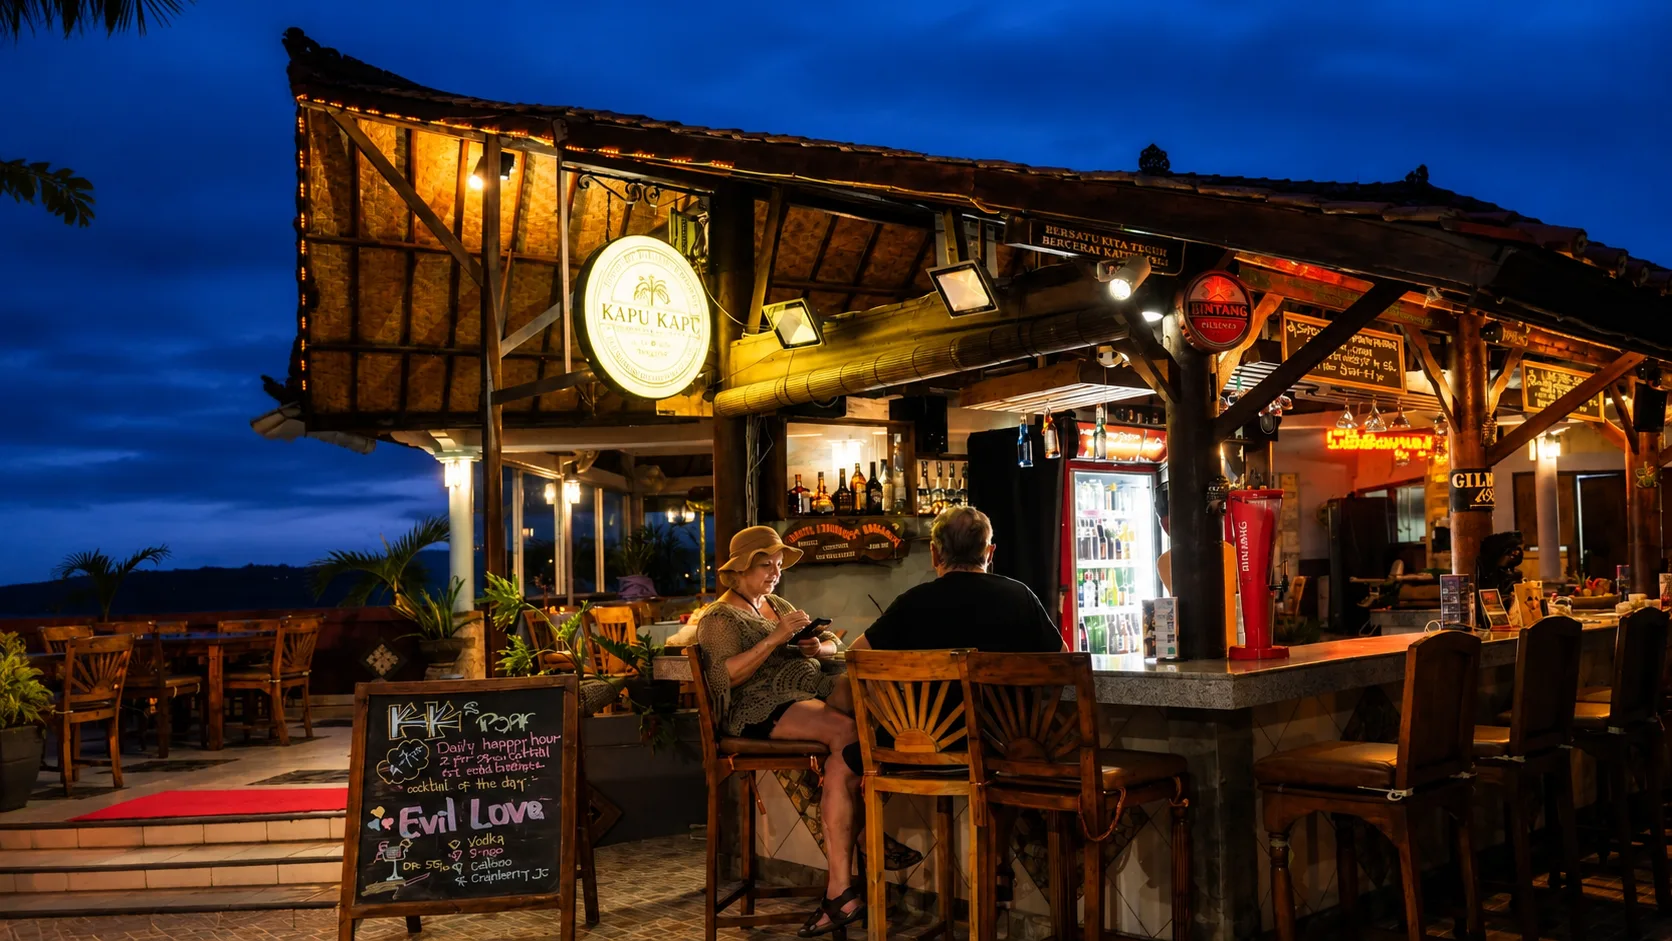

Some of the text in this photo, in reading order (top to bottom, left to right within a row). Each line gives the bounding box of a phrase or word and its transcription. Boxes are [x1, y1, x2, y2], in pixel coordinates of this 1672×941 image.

[1045, 224, 1099, 244] BERSATU
[1101, 236, 1128, 250] KITA
[602, 302, 649, 326] KAPU
[1191, 303, 1248, 317] BINTANG
[530, 731, 561, 746] hour
[476, 777, 497, 790] the
[399, 796, 545, 839] Evil Love
